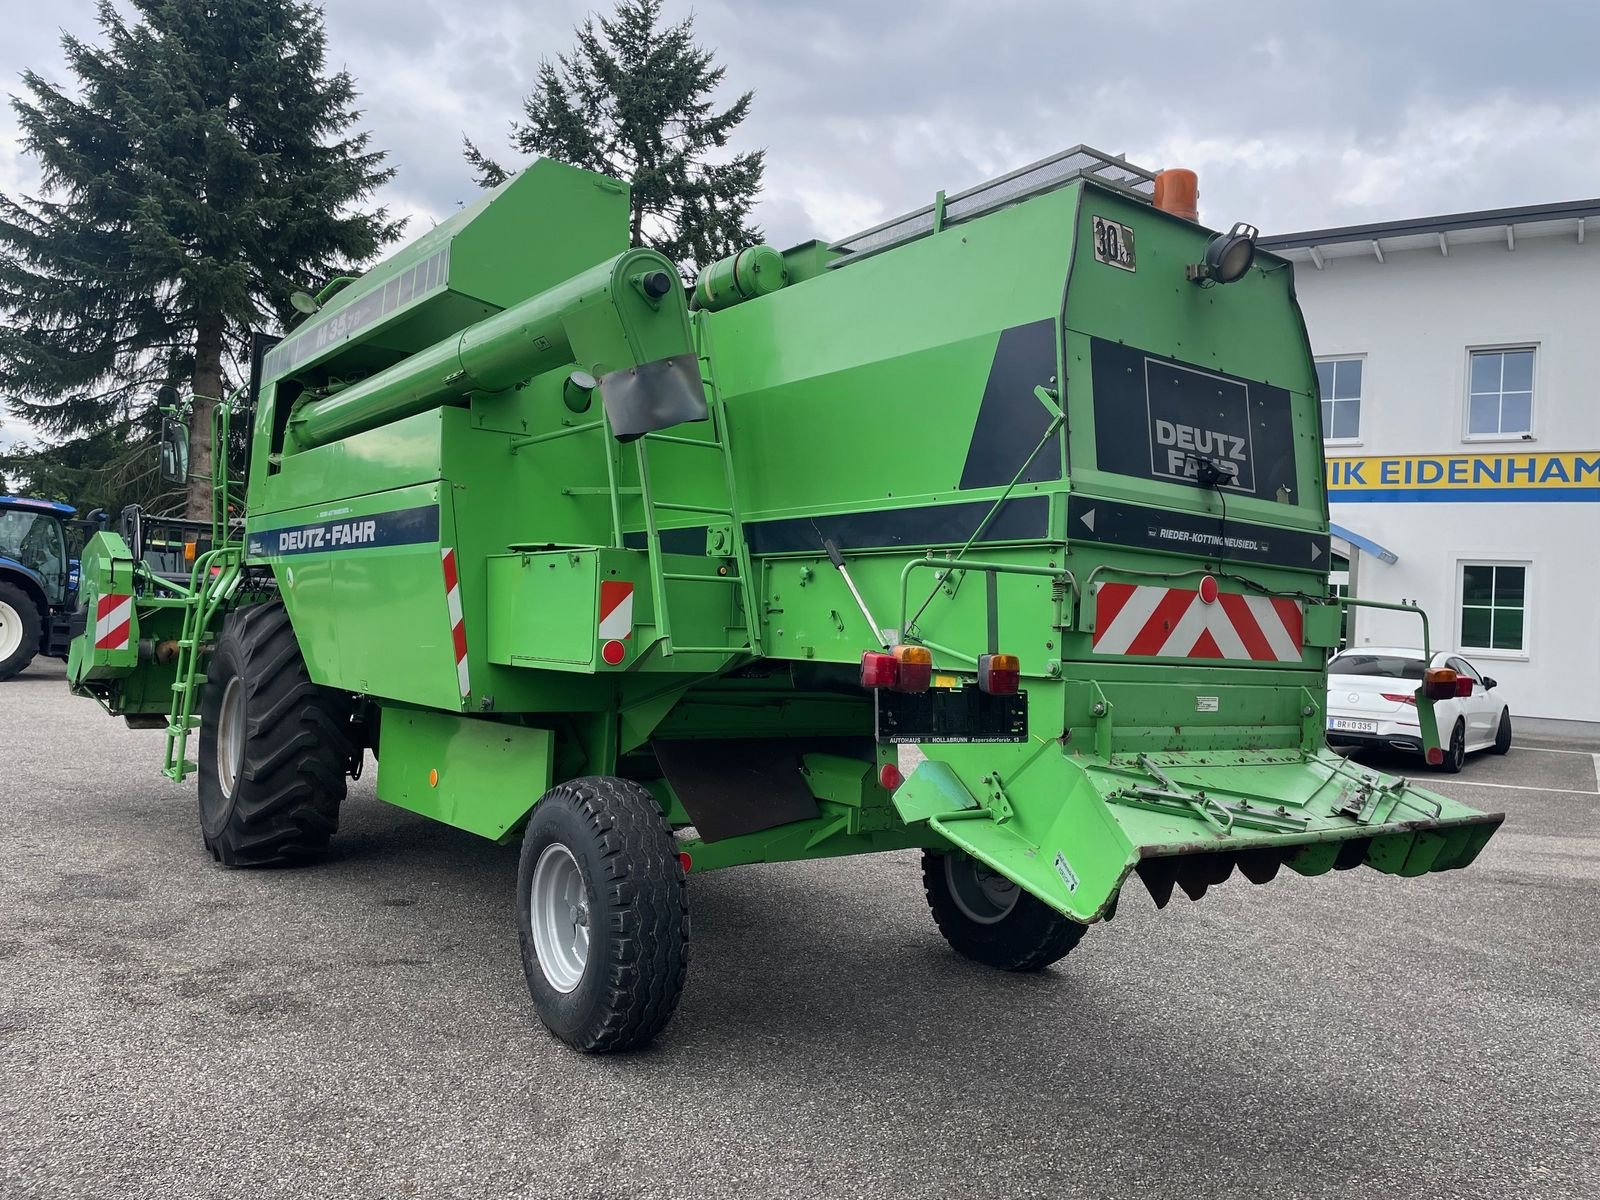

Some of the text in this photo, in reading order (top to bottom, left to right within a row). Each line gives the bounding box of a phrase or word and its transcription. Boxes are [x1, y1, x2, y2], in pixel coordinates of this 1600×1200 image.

[1096, 221, 1118, 260] 30
[1156, 419, 1246, 461] DEUTZ
[1167, 449, 1240, 486] FAR
[1325, 457, 1600, 485] IK EIDENHAM
[279, 520, 376, 551] DEUTZ-FAHR
[1337, 720, 1347, 729] BR
